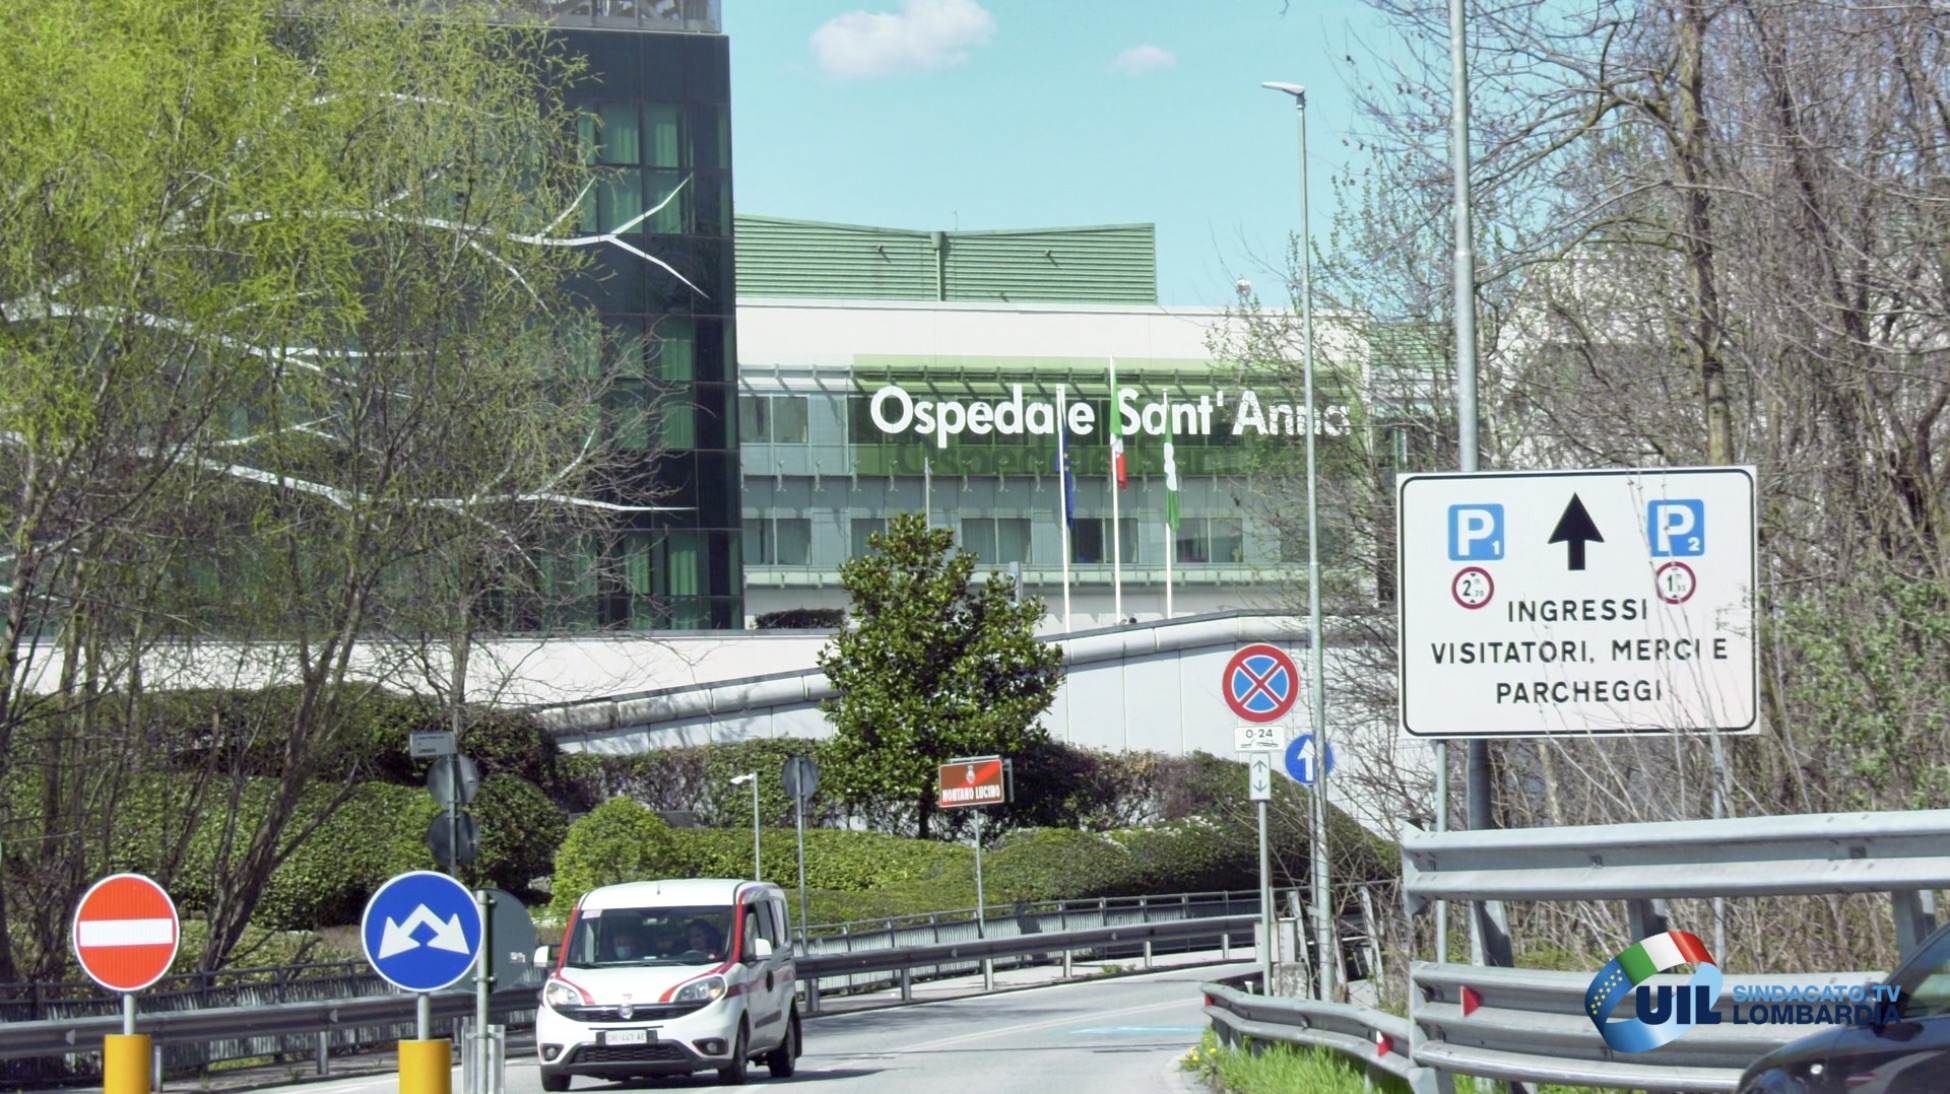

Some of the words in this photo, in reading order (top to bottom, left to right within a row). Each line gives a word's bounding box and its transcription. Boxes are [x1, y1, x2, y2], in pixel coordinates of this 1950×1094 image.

[870, 384, 1095, 448] Ospedale
[1508, 599, 1648, 622] INGRESSI
[1431, 640, 1595, 664] VISITATORI,
[1611, 638, 1700, 661] MERCI
[1713, 638, 1728, 660] E
[1496, 680, 1661, 704] PARCHEGGI
[1245, 728, 1273, 739] 0-24
[942, 787, 974, 802] MONTANO
[975, 784, 1000, 800] LUCINO
